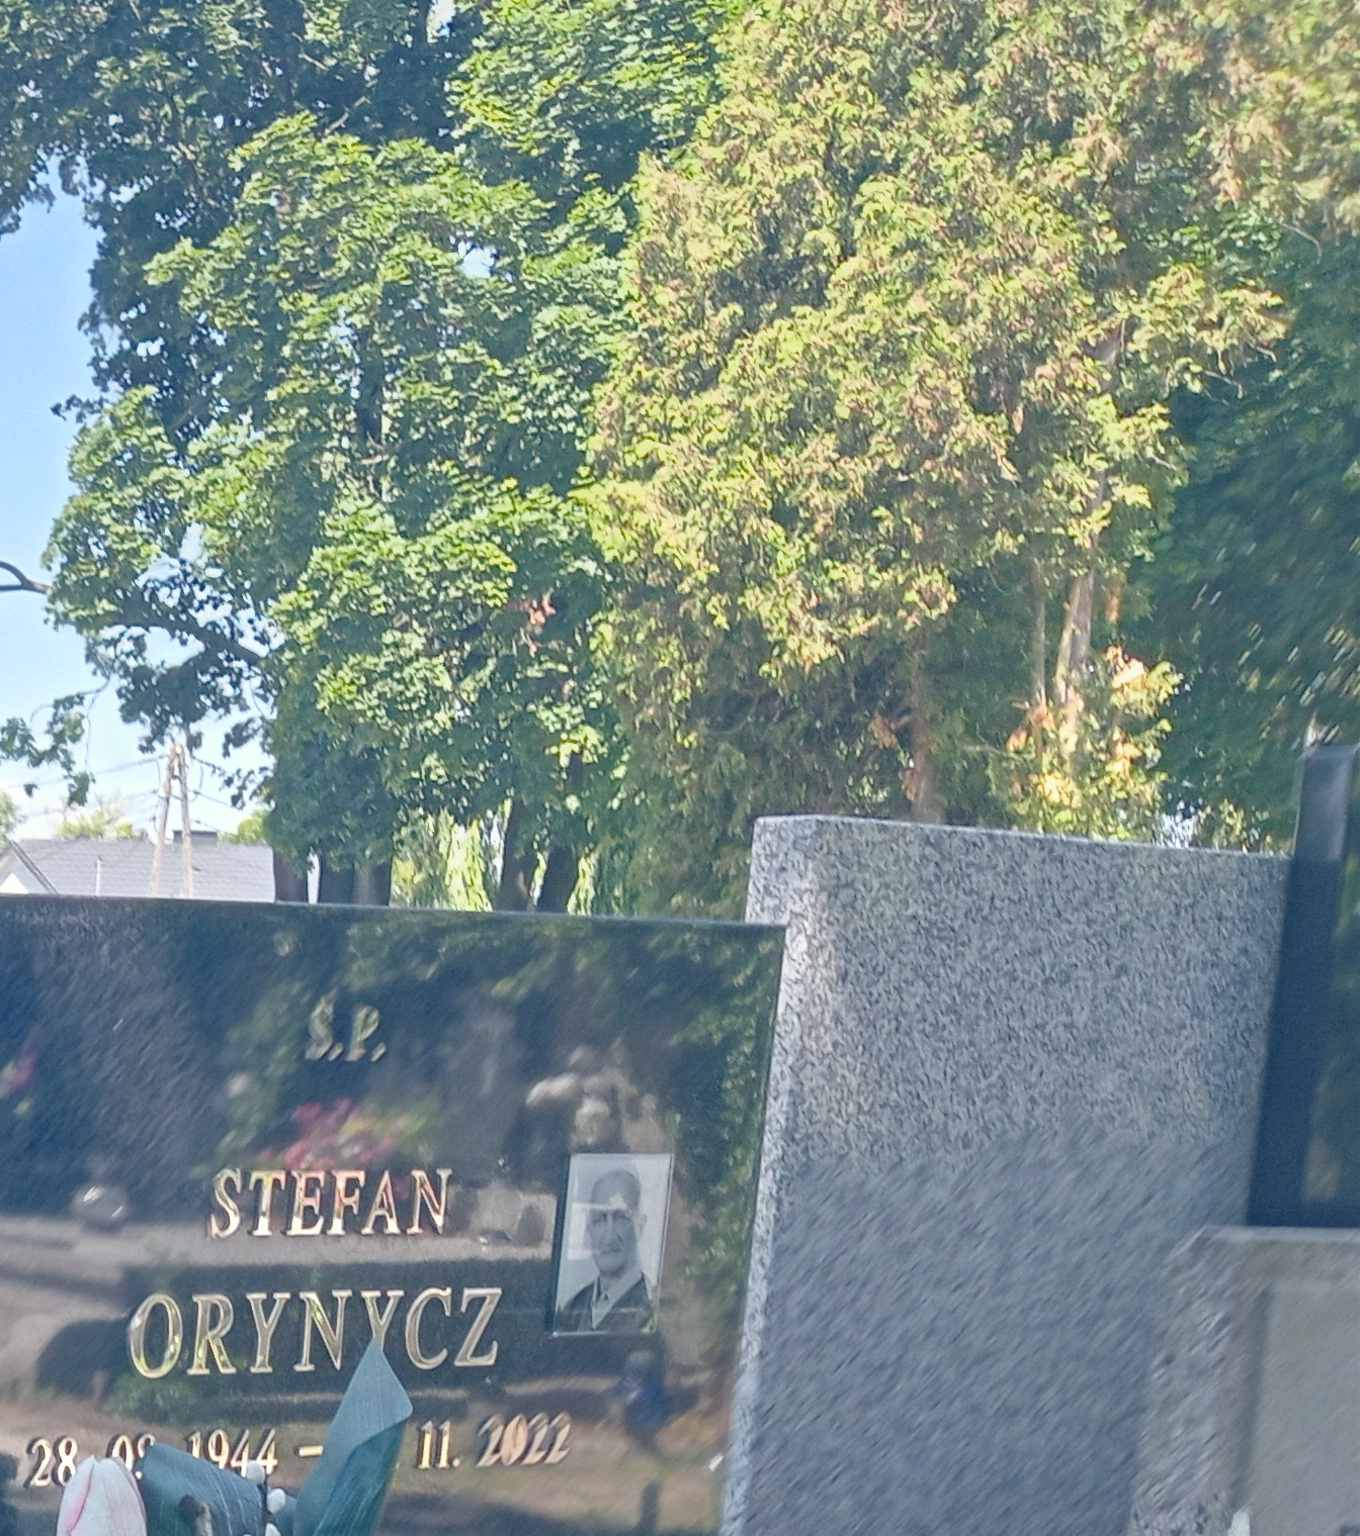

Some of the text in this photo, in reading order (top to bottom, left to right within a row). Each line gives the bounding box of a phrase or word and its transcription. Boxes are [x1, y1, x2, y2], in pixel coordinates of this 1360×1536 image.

[208, 1167, 454, 1240] STEFAN
[128, 1286, 503, 1380] ORYNYCZ
[475, 1411, 571, 1468] 2022
